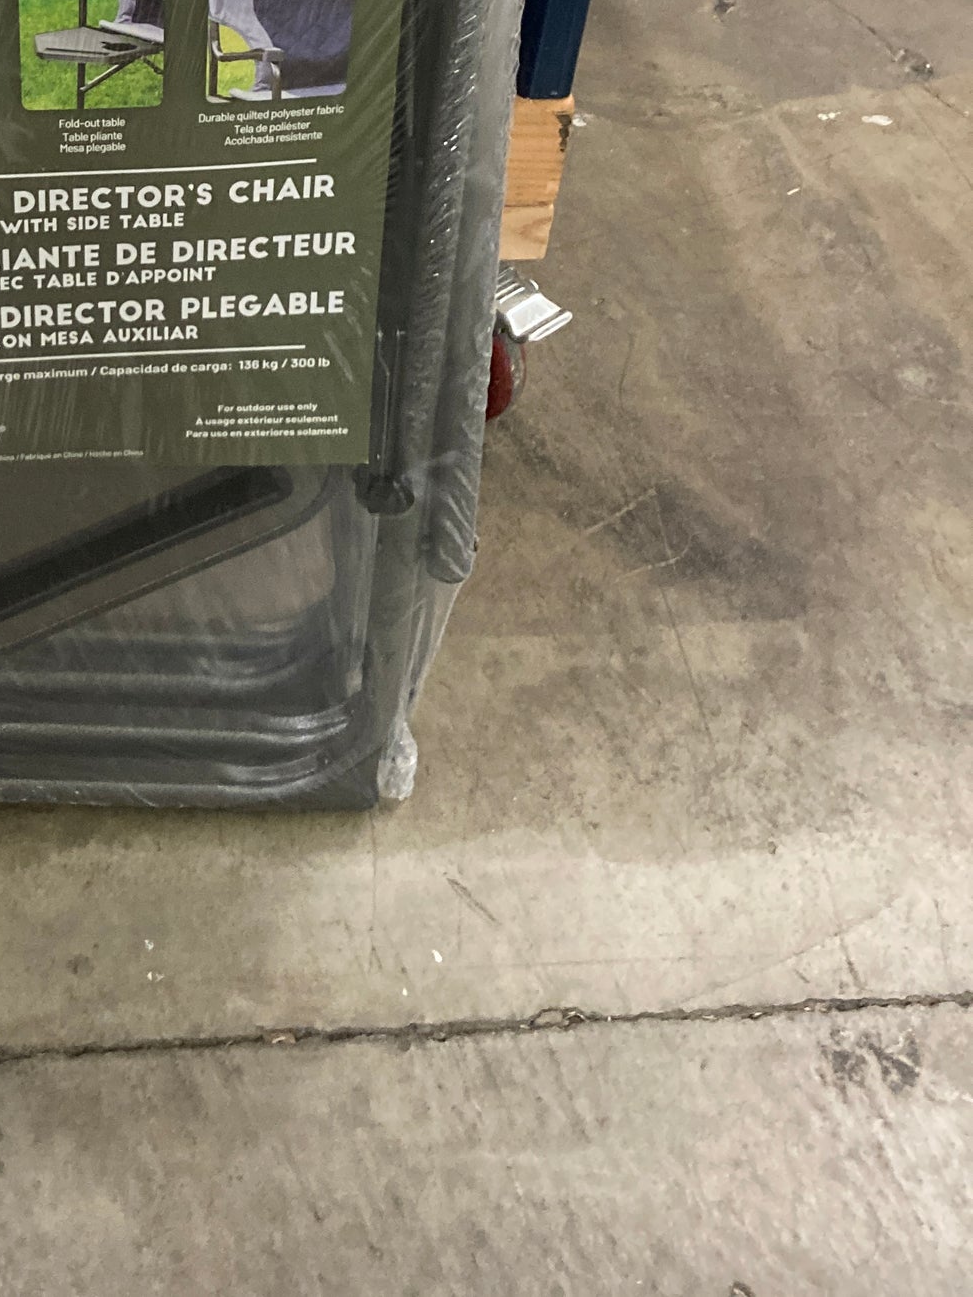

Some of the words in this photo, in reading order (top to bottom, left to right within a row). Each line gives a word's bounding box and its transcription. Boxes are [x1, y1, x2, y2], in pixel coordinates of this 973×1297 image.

[198, 111, 235, 123] Durable
[237, 109, 270, 122] quilted
[270, 106, 316, 121] polyester
[316, 104, 345, 115] fabric
[59, 118, 100, 129] Fold-out
[102, 117, 126, 127] table
[234, 123, 254, 134] Tela
[255, 122, 269, 133] de
[269, 120, 312, 133] poliéster
[62, 132, 89, 142] Table
[90, 131, 123, 143] pliante
[224, 134, 275, 147] Acolchada
[275, 131, 323, 143] resistente
[60, 143, 85, 154] Mesa
[86, 142, 127, 155] plegable
[13, 182, 213, 214] DIRECTOR'S
[228, 174, 335, 204] CHAIR
[0, 216, 58, 234] WITH
[66, 215, 110, 231] SIDE
[119, 212, 185, 229] TABLE
[116, 241, 157, 265] DE
[172, 231, 356, 263] DIRECTEUR
[33, 271, 97, 289] TABLE
[106, 266, 217, 286] D'APPOINT
[0, 298, 166, 329] DIRECTOR
[181, 290, 345, 320] PLEGABLE
[40, 330, 94, 346] MESA
[103, 324, 199, 343] AUXILIAR
[23, 366, 89, 381] maximum
[99, 362, 169, 379] Capacidad
[171, 361, 187, 374] de
[190, 362, 233, 375] carga:
[238, 359, 260, 371] 136
[262, 358, 279, 373] kg
[290, 357, 316, 369] 300
[317, 356, 331, 369] lb
[217, 404, 235, 414] For
[236, 403, 275, 413] outdoor
[277, 404, 295, 412] use
[297, 402, 319, 413] only
[205, 417, 236, 427] usage
[237, 415, 284, 425] extérieur
[285, 413, 339, 424] seulement
[186, 429, 209, 438] Para
[210, 429, 228, 438] uso
[230, 429, 243, 438] en
[244, 427, 296, 437] exteriores
[296, 426, 349, 436] solamente
